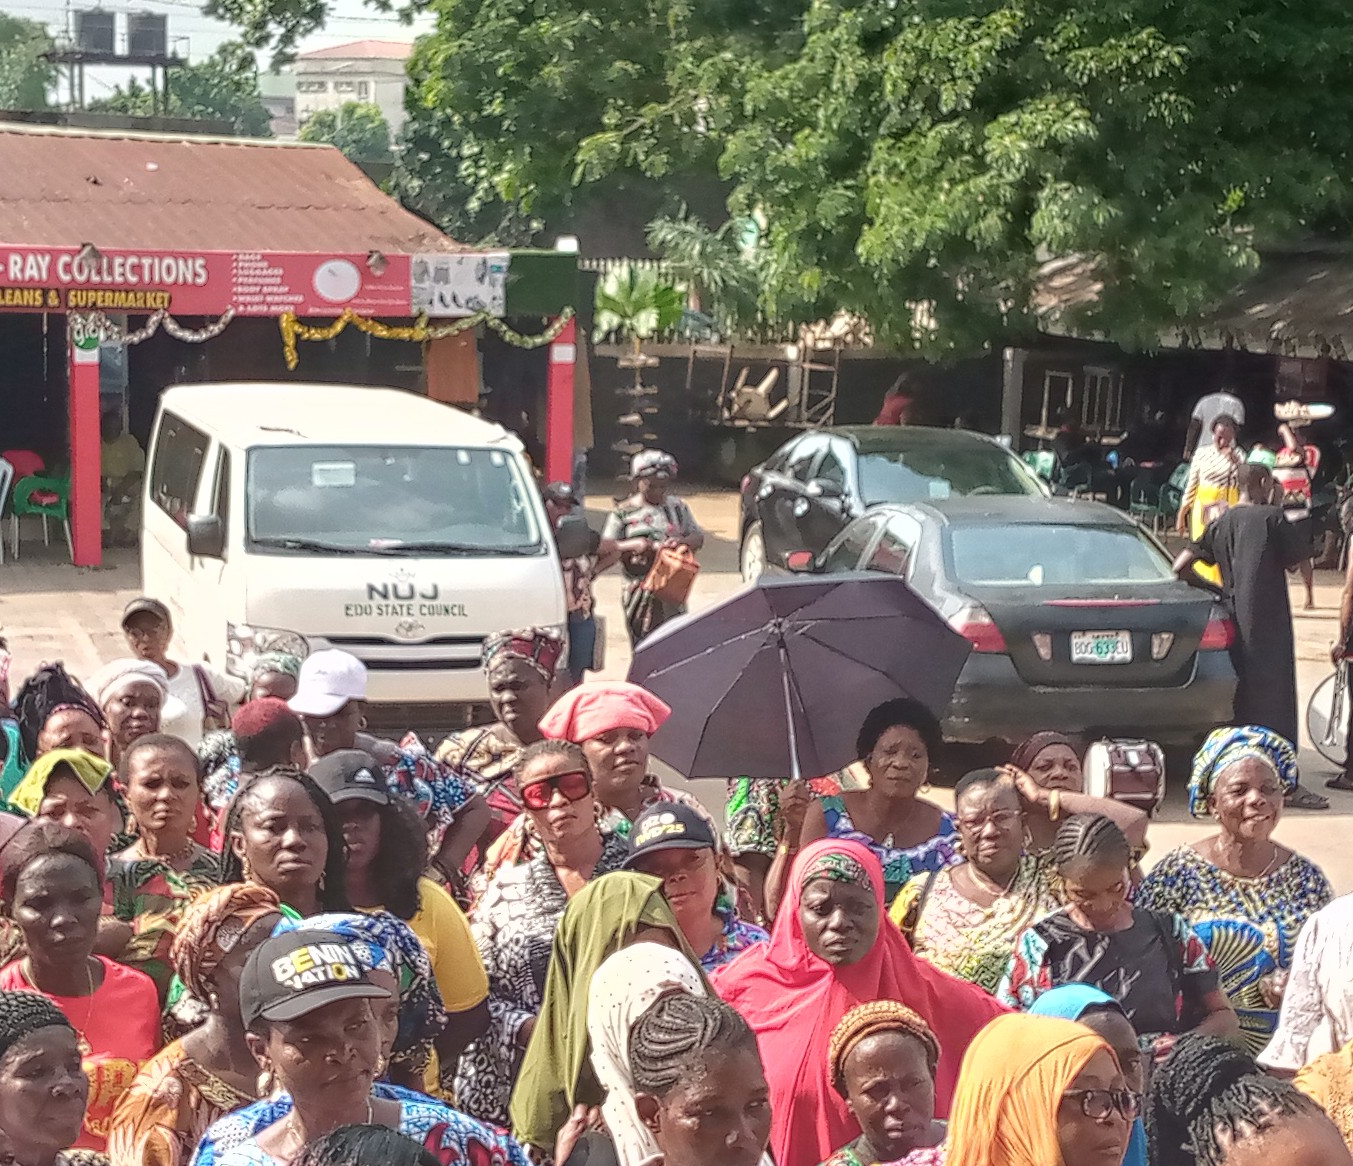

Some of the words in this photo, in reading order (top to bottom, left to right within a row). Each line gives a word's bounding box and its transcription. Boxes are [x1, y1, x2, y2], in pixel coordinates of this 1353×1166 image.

[57, 254, 209, 287] COLLECTIONS
[48, 290, 60, 307] &
[66, 289, 170, 309] SUPERMARKET
[367, 583, 439, 600] NUJ
[345, 604, 372, 617] EDO
[377, 604, 415, 617] STATE
[419, 604, 468, 617] COUNCIL
[272, 943, 352, 981] BENIN
[283, 963, 361, 990] NATION
